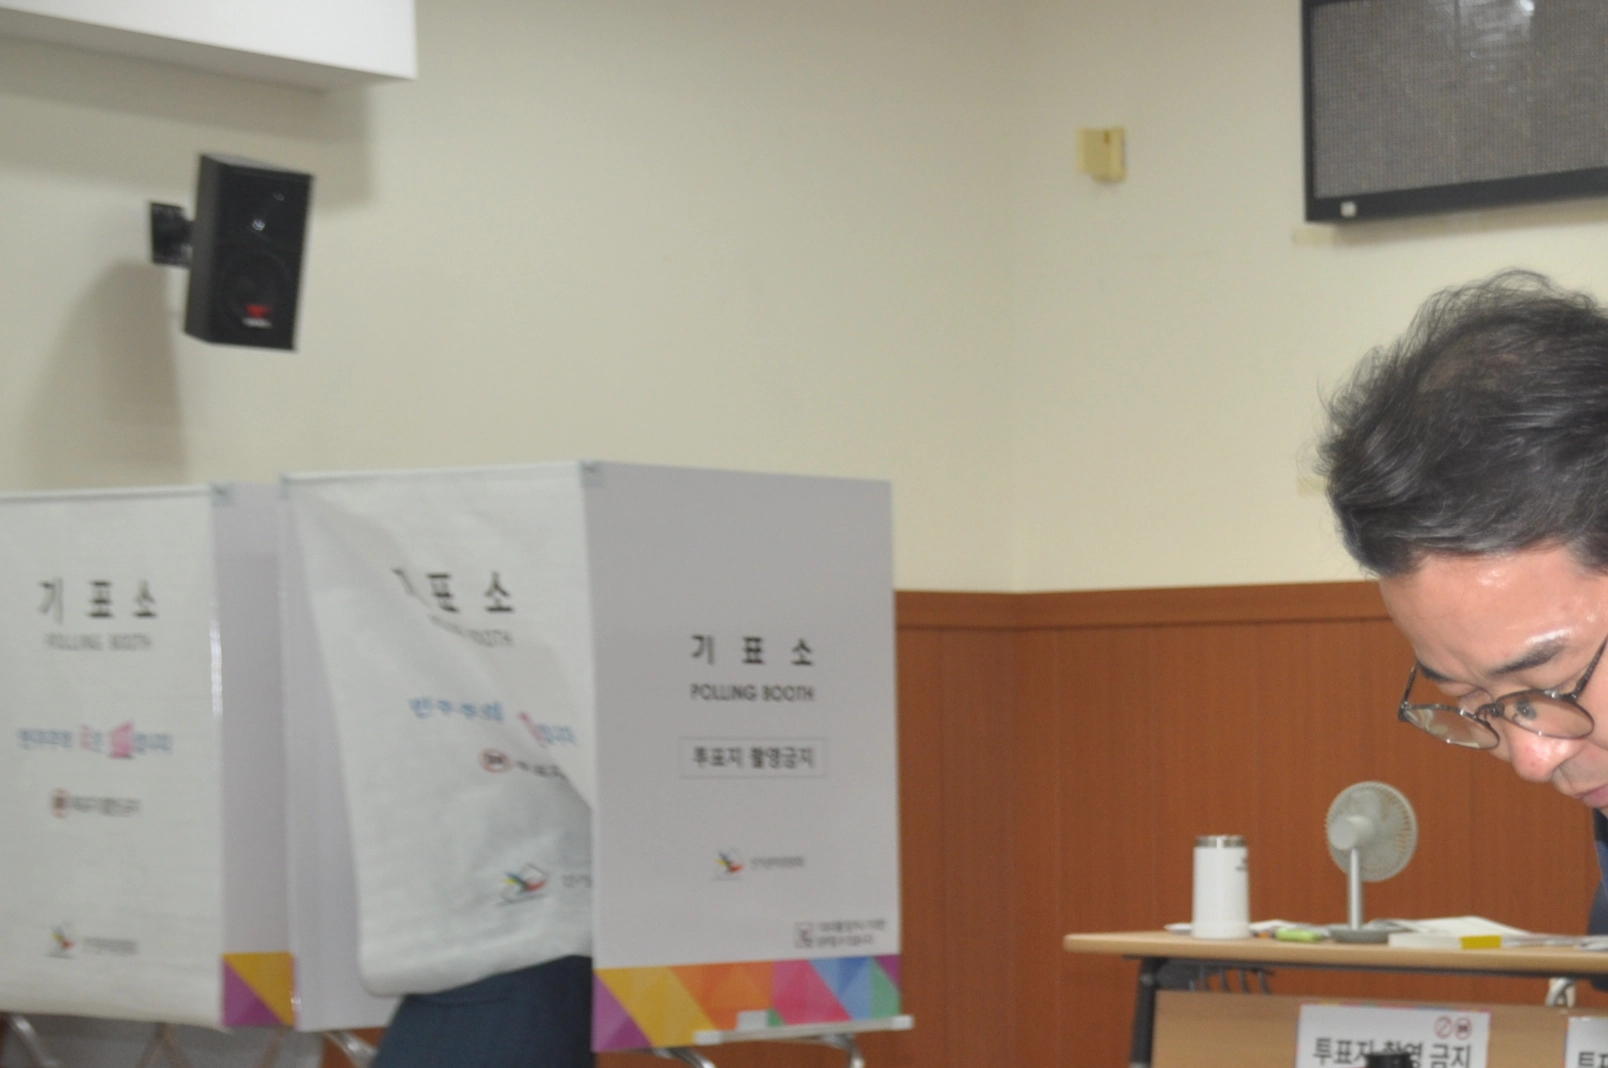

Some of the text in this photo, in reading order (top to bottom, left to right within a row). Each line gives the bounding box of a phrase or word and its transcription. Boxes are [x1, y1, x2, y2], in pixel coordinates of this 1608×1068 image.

[691, 634, 814, 667] 기표소
[690, 683, 815, 701] POLLING BOOTH
[693, 746, 743, 769] 투표지
